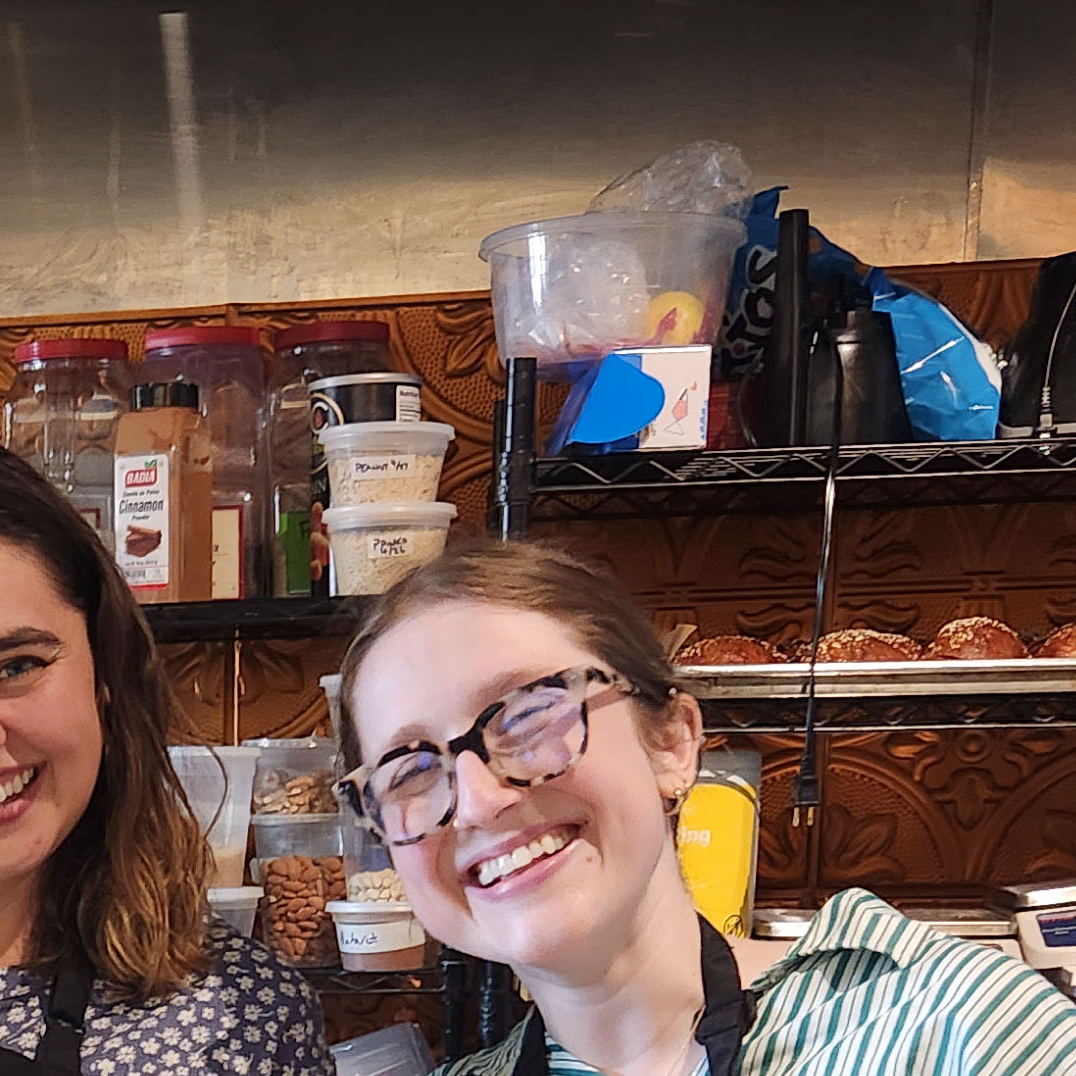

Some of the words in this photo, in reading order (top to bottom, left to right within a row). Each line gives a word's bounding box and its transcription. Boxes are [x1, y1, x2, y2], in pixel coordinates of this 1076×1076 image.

[126, 468, 156, 485] BADIA
[119, 499, 164, 514] Cinnamon
[681, 825, 711, 848] ing
